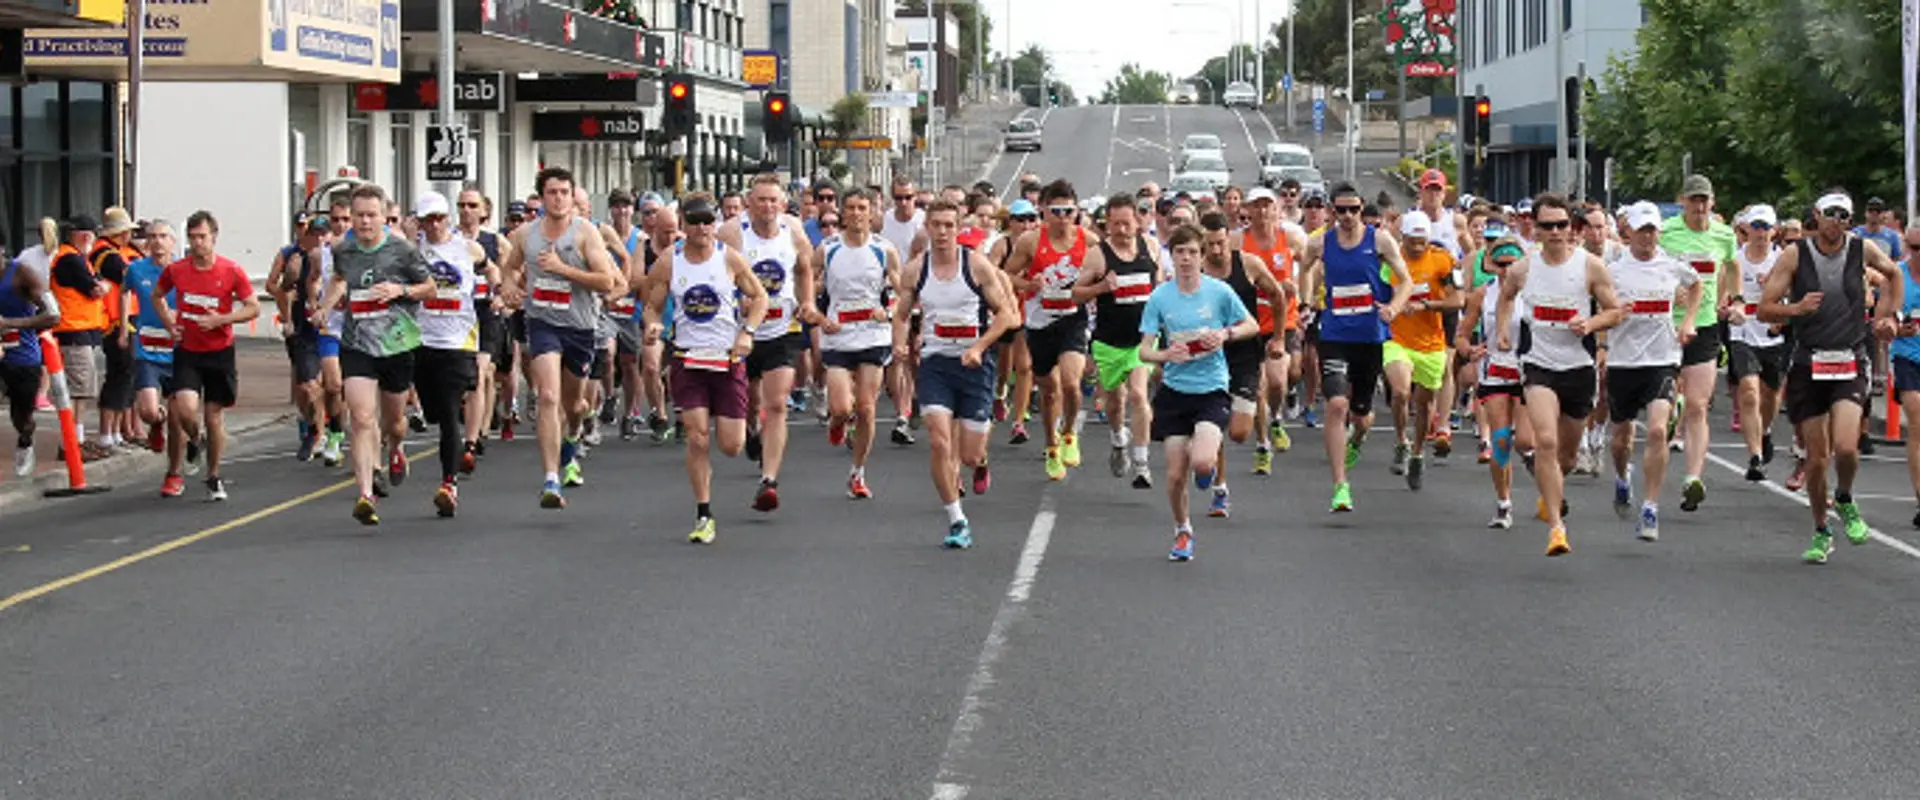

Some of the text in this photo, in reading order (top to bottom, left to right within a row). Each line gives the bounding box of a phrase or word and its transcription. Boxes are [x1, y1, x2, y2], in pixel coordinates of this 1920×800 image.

[38, 39, 125, 54] Practising
[453, 78, 496, 100] nab
[603, 115, 640, 134] nab
